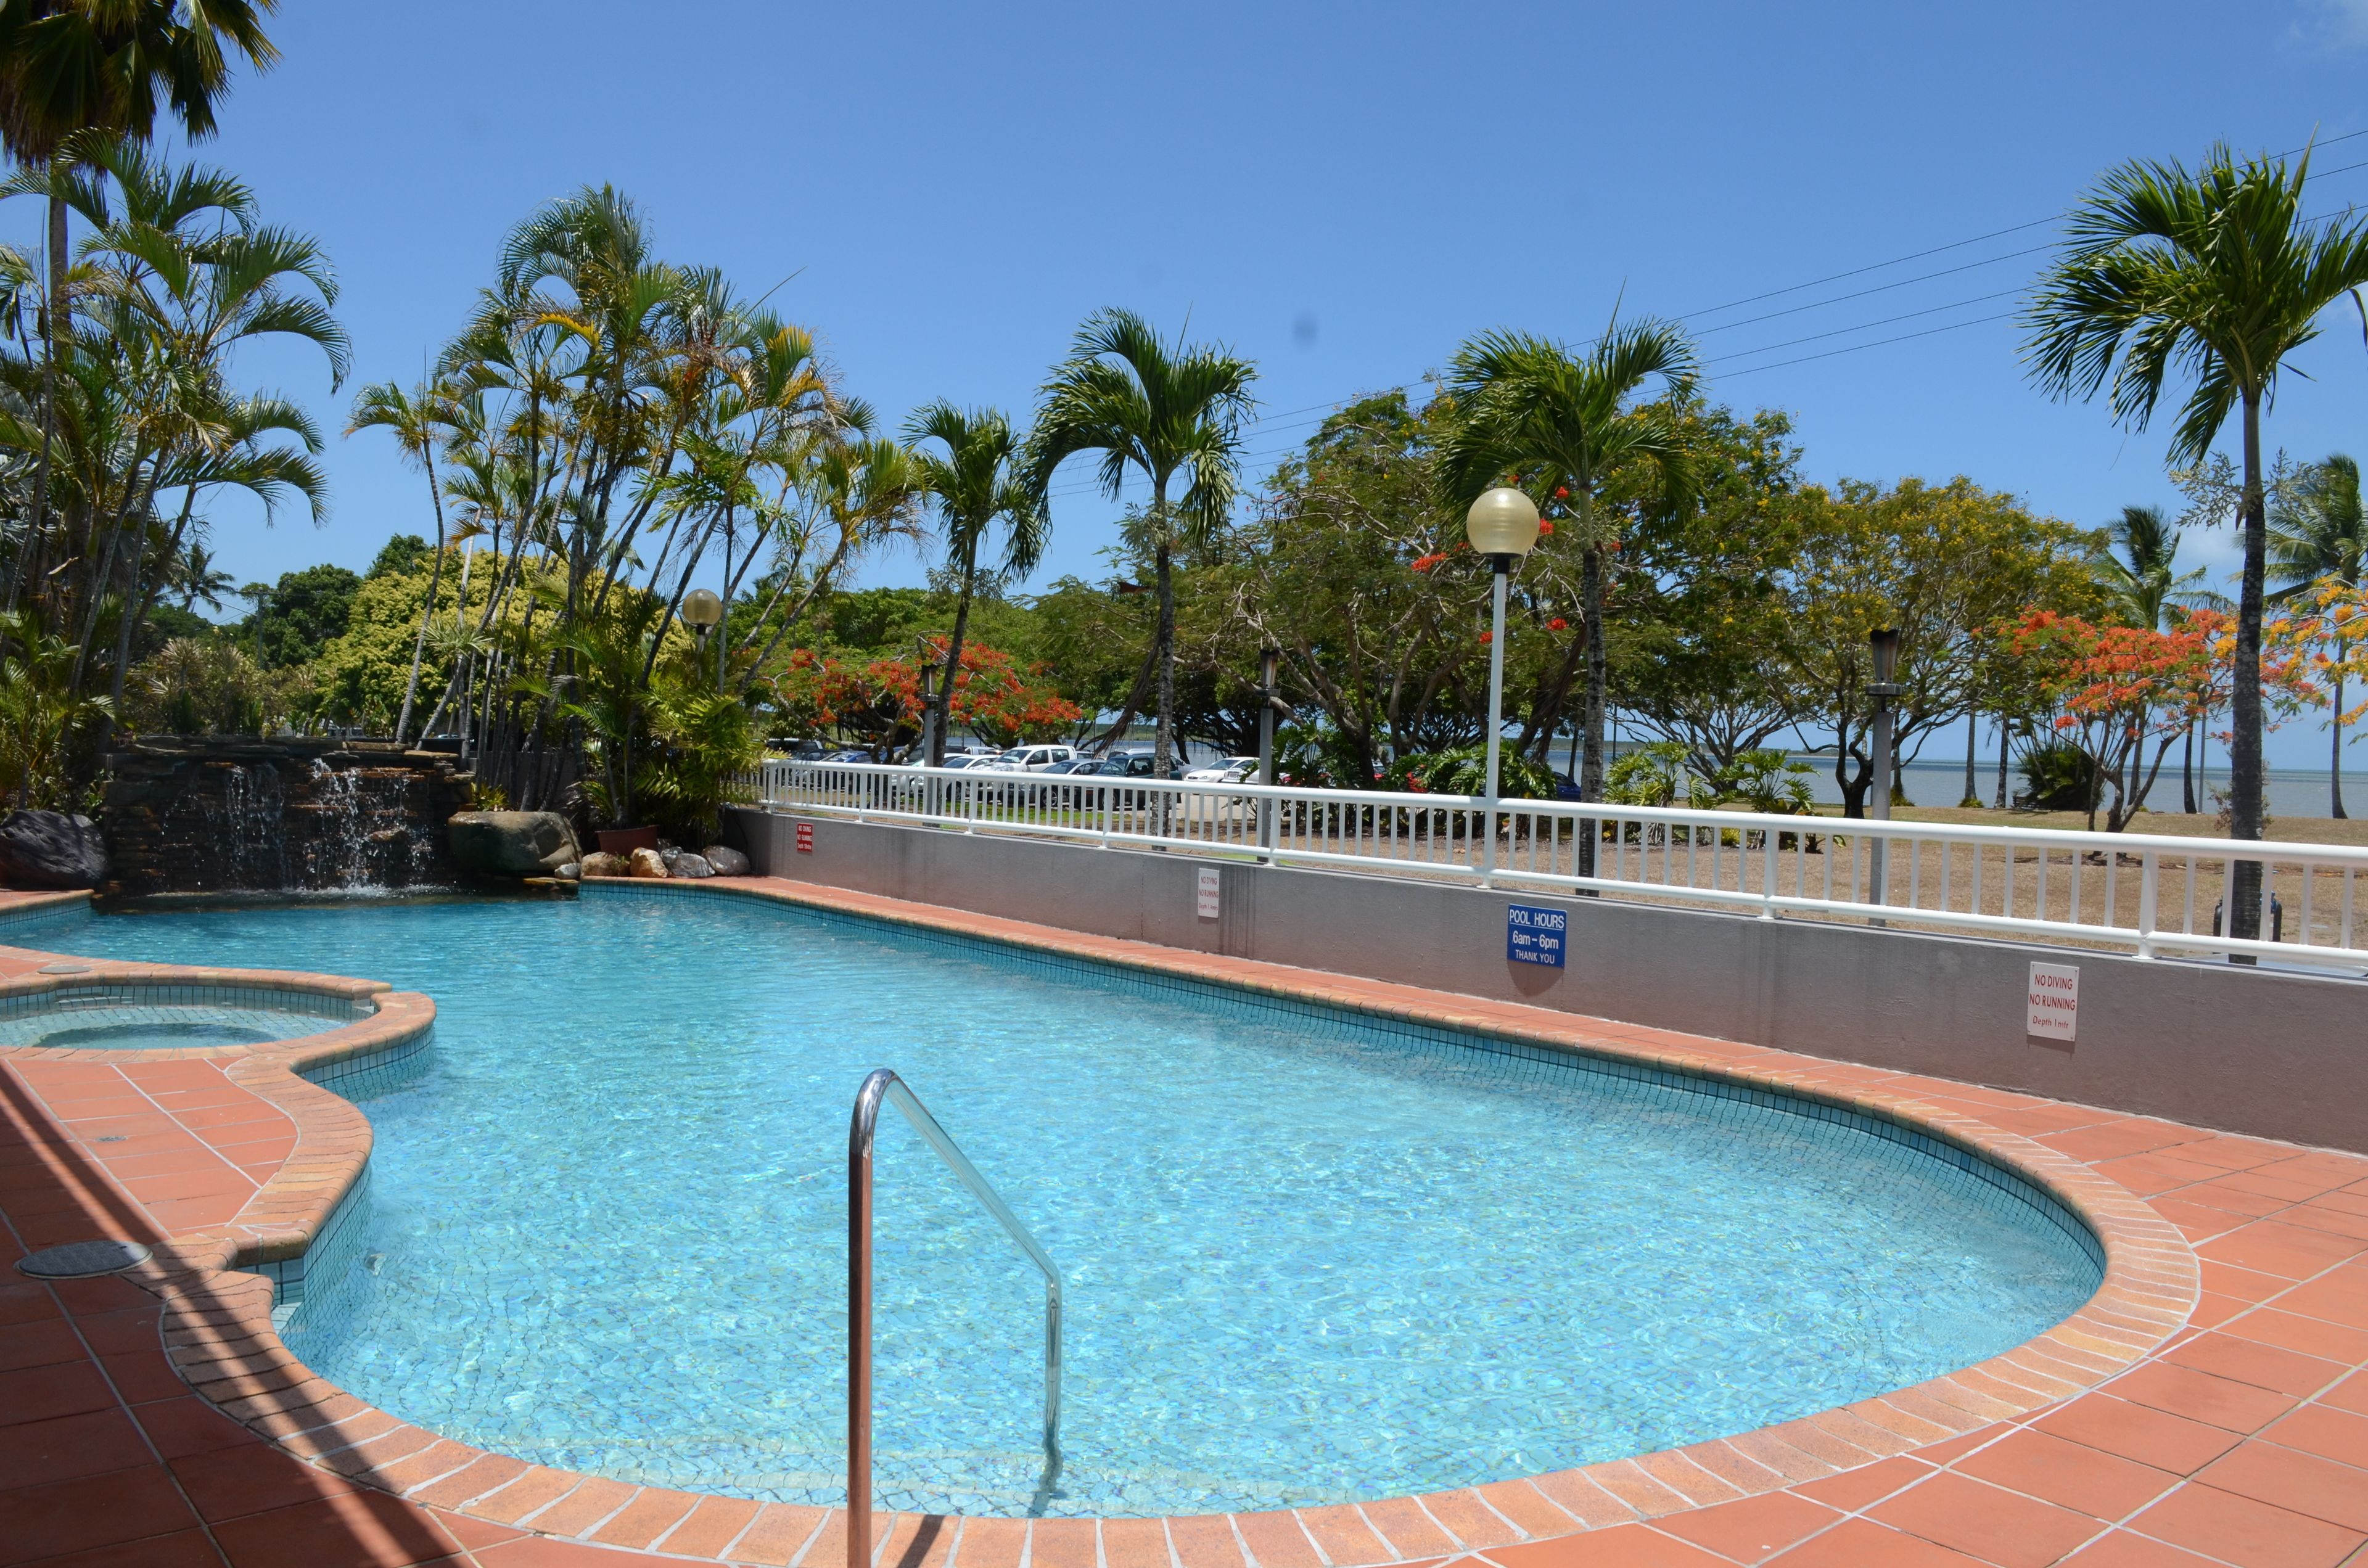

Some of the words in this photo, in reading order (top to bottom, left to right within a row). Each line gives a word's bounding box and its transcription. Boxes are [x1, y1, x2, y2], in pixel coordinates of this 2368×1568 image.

[1201, 876, 1206, 884] NO
[1206, 877, 1217, 885] DIVING
[1204, 890, 1219, 898] RUNNING
[1509, 909, 1531, 925] POOL
[1534, 912, 1564, 929] HOURS
[1515, 949, 1538, 962] THANK
[1539, 953, 1555, 964] YOU
[2034, 974, 2046, 987] NO
[2047, 976, 2073, 990] DIVING
[2029, 993, 2041, 1005] NO
[2042, 995, 2076, 1011] RUNNING
[2033, 1016, 2052, 1027] Depth
